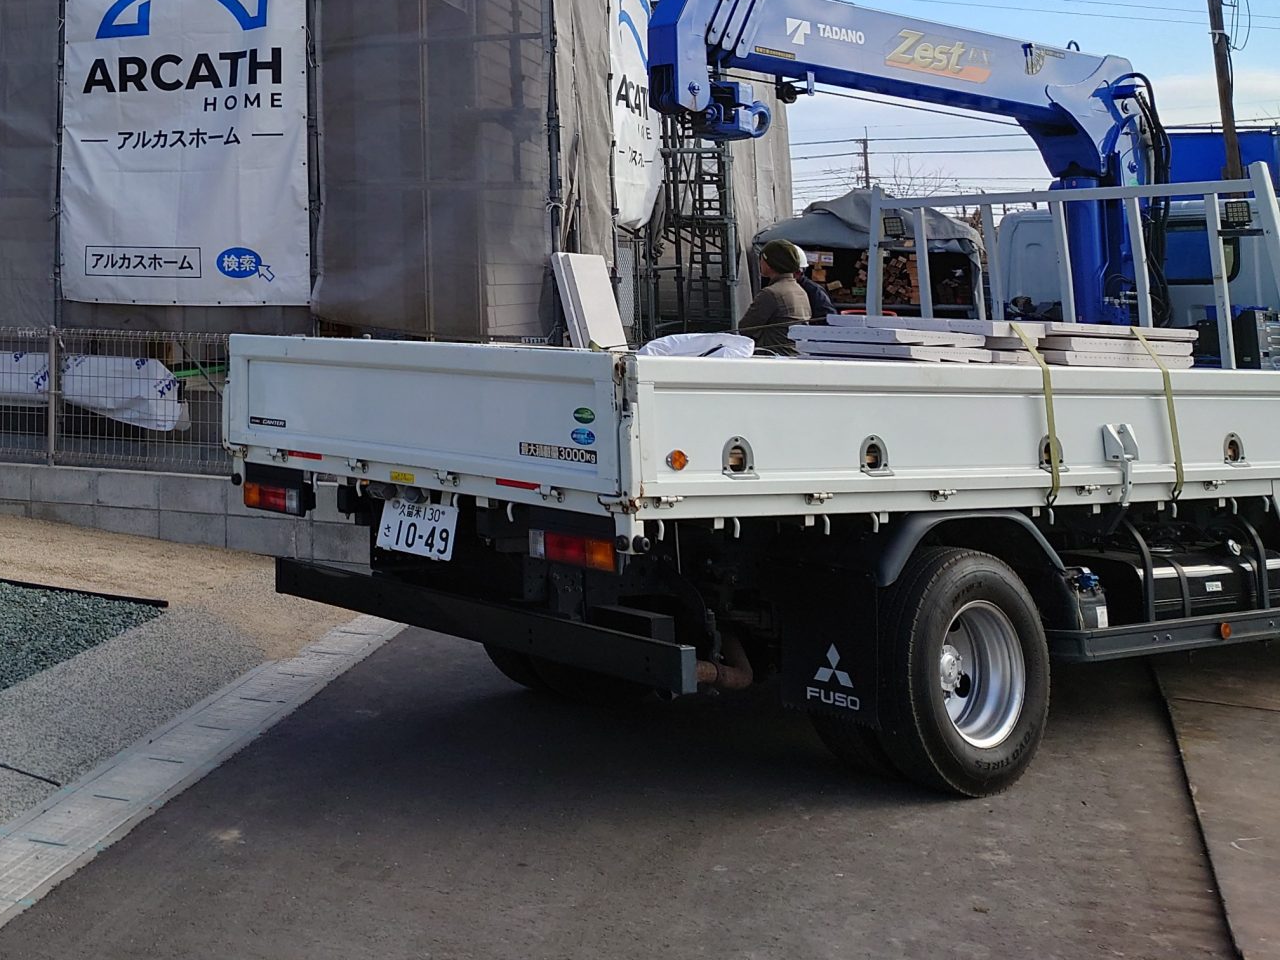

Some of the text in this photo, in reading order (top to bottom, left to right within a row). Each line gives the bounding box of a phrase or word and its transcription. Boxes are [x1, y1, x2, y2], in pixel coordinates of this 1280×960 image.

[817, 23, 865, 45] TADANO
[885, 28, 966, 74] Zest
[82, 46, 282, 94] ARCATH
[203, 92, 283, 112] HOME
[117, 127, 241, 150] アルカスホーム
[90, 253, 195, 271] アルカスホーム
[222, 254, 256, 272] 検索
[395, 520, 450, 555] 10-49
[806, 686, 860, 711] FUSO
[974, 756, 1010, 771] TIRES
